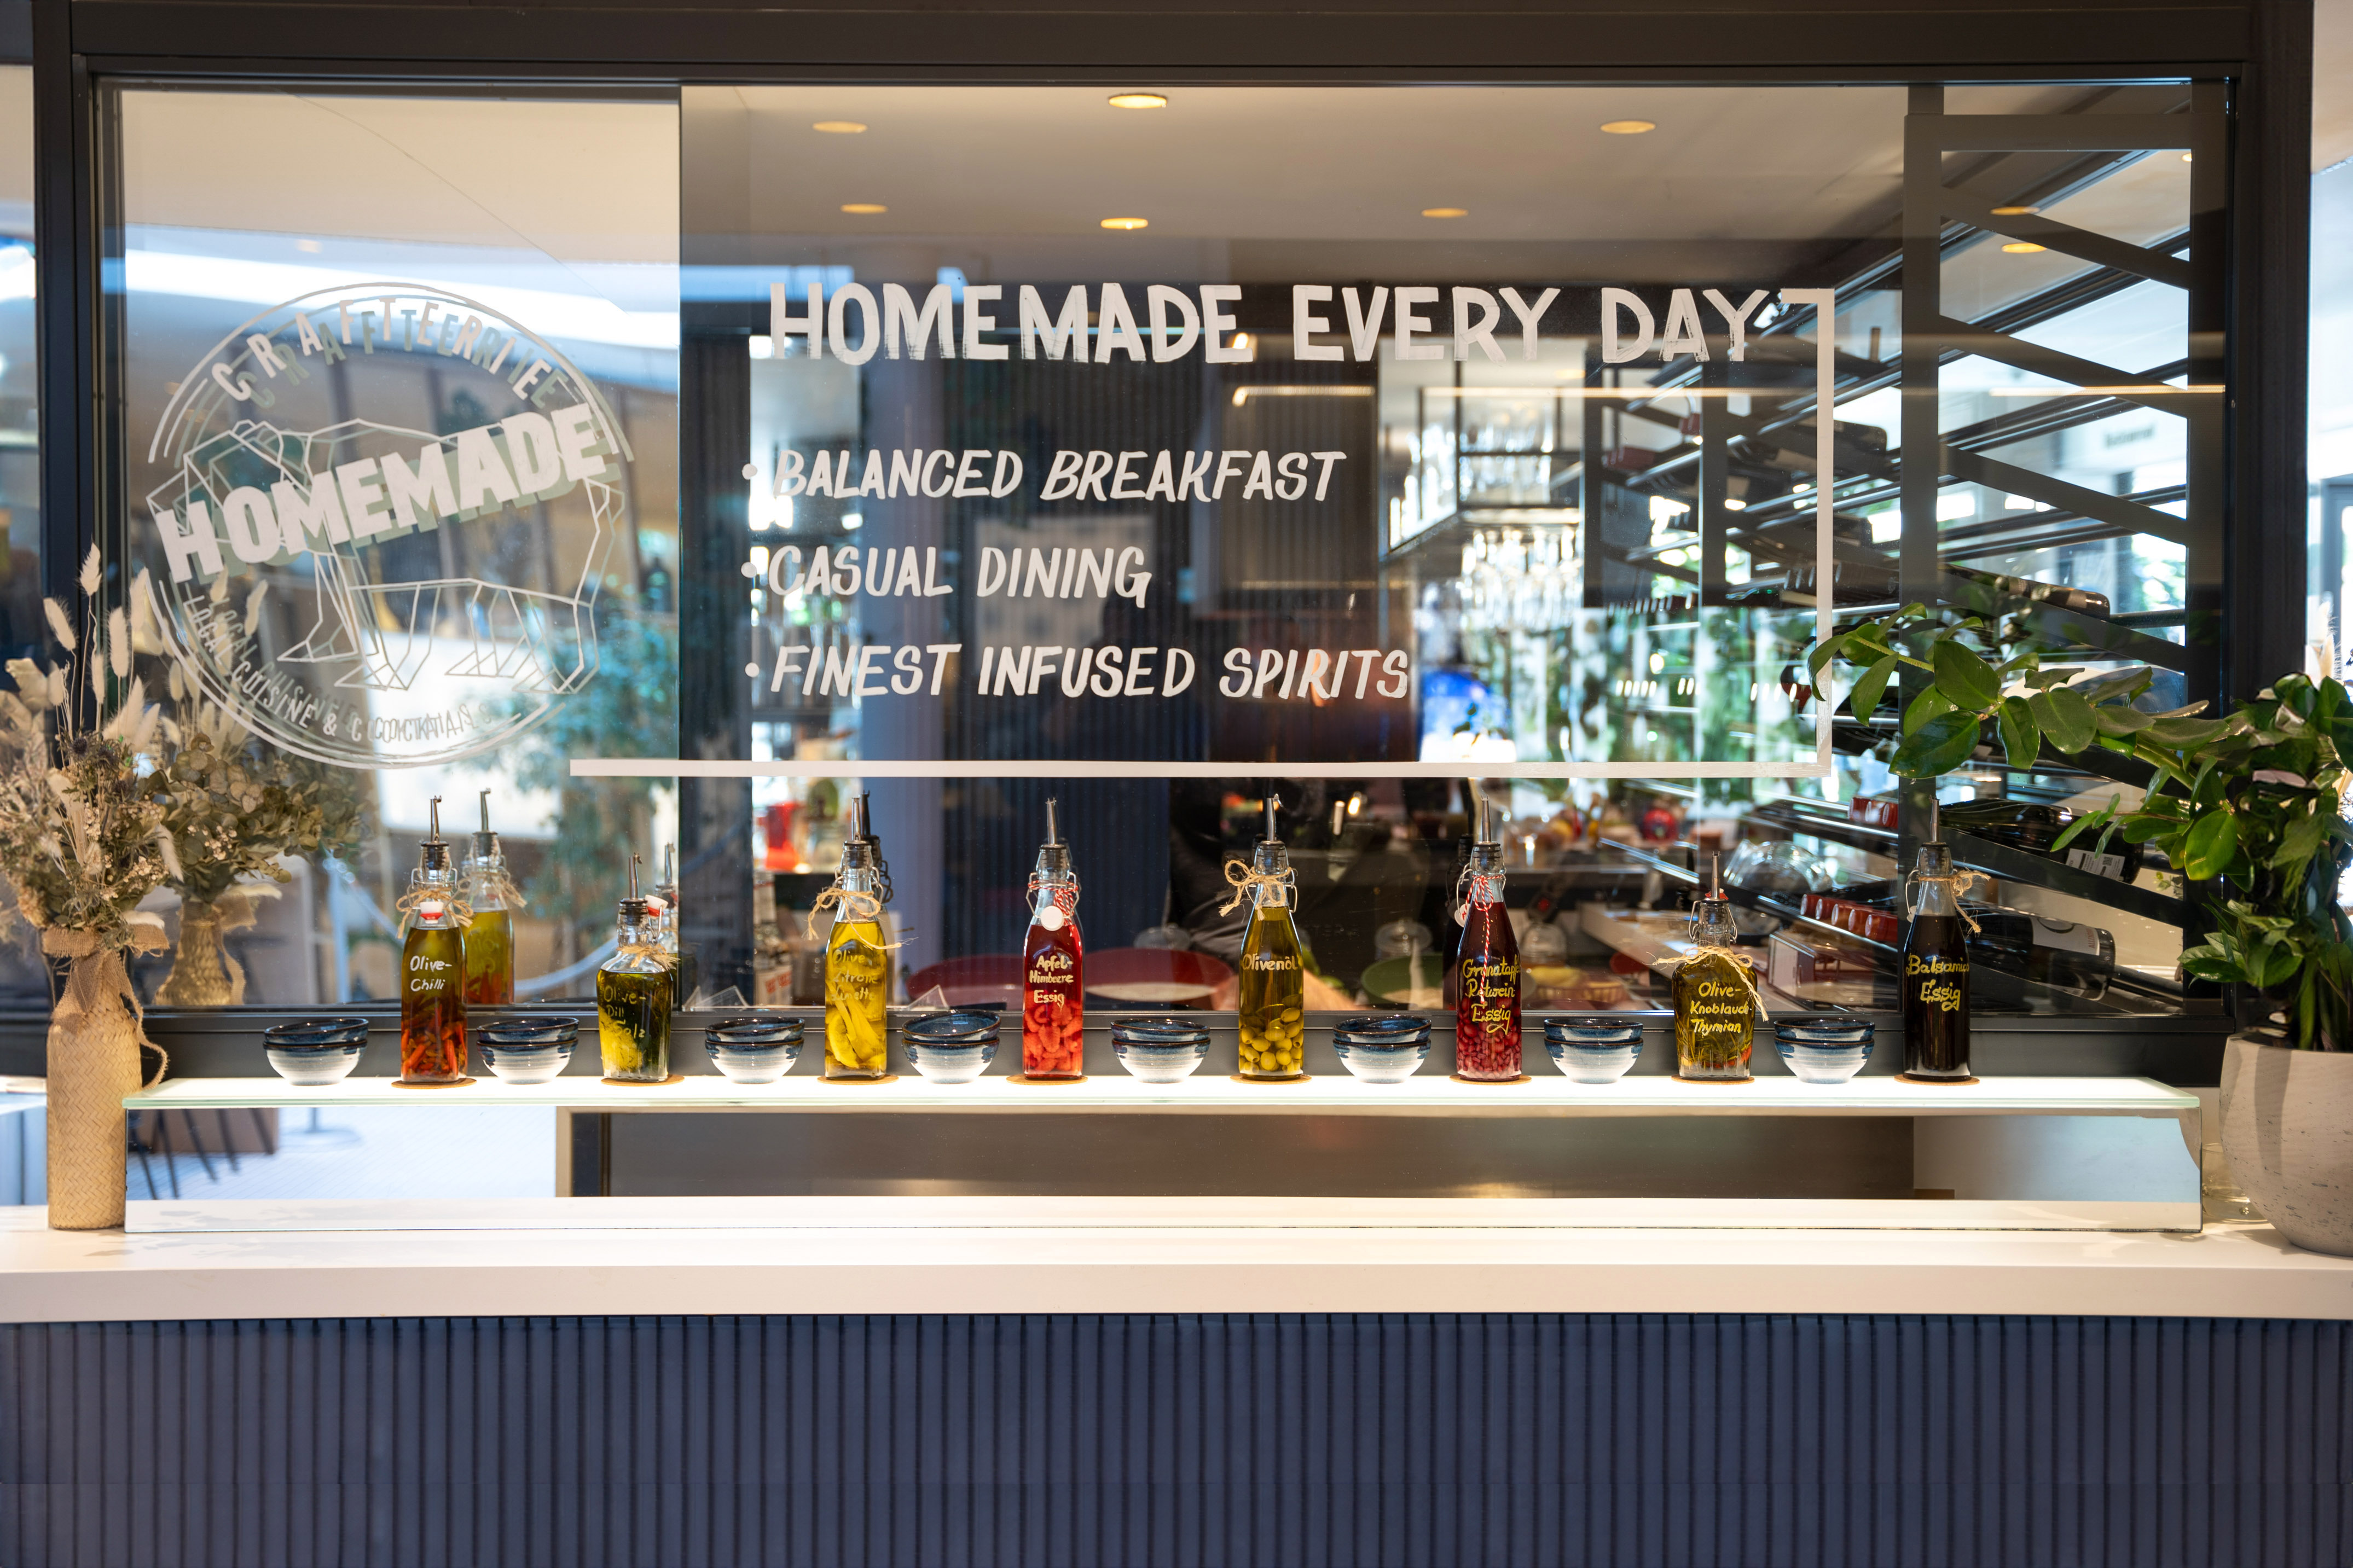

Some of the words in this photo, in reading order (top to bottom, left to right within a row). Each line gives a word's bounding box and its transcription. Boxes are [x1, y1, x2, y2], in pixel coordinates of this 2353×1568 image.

[769, 282, 1254, 365] HOMEMADE
[1293, 285, 1561, 365] EVERY
[1601, 287, 1771, 363] DAY
[211, 297, 552, 402] CRAFTERIE
[772, 449, 1023, 500] BALANCED
[1039, 449, 1347, 502] BREAKFAST
[155, 403, 607, 584] HOMEMADE
[767, 545, 953, 597] CASUAL
[976, 545, 1153, 609] DINING
[183, 595, 234, 669] LOCAL
[231, 660, 317, 729] CUISINE
[322, 712, 338, 737] &
[770, 643, 963, 696] FINEST
[977, 646, 1196, 698] INFUSED
[1218, 648, 1409, 700] SPIRITS
[409, 955, 453, 973] Olive-
[832, 949, 866, 964] Olive
[1242, 953, 1299, 971] Olivenöl
[410, 978, 446, 992] Chilli
[832, 967, 878, 984] Zitrone
[604, 985, 647, 1005] Olive-
[1033, 989, 1065, 1011] Essig
[1698, 981, 1742, 997] Olive-
[1920, 978, 1961, 1012] Essig
[606, 1004, 625, 1018] Dill
[1470, 1001, 1511, 1036] Essig
[1690, 1018, 1742, 1039] Thymian
